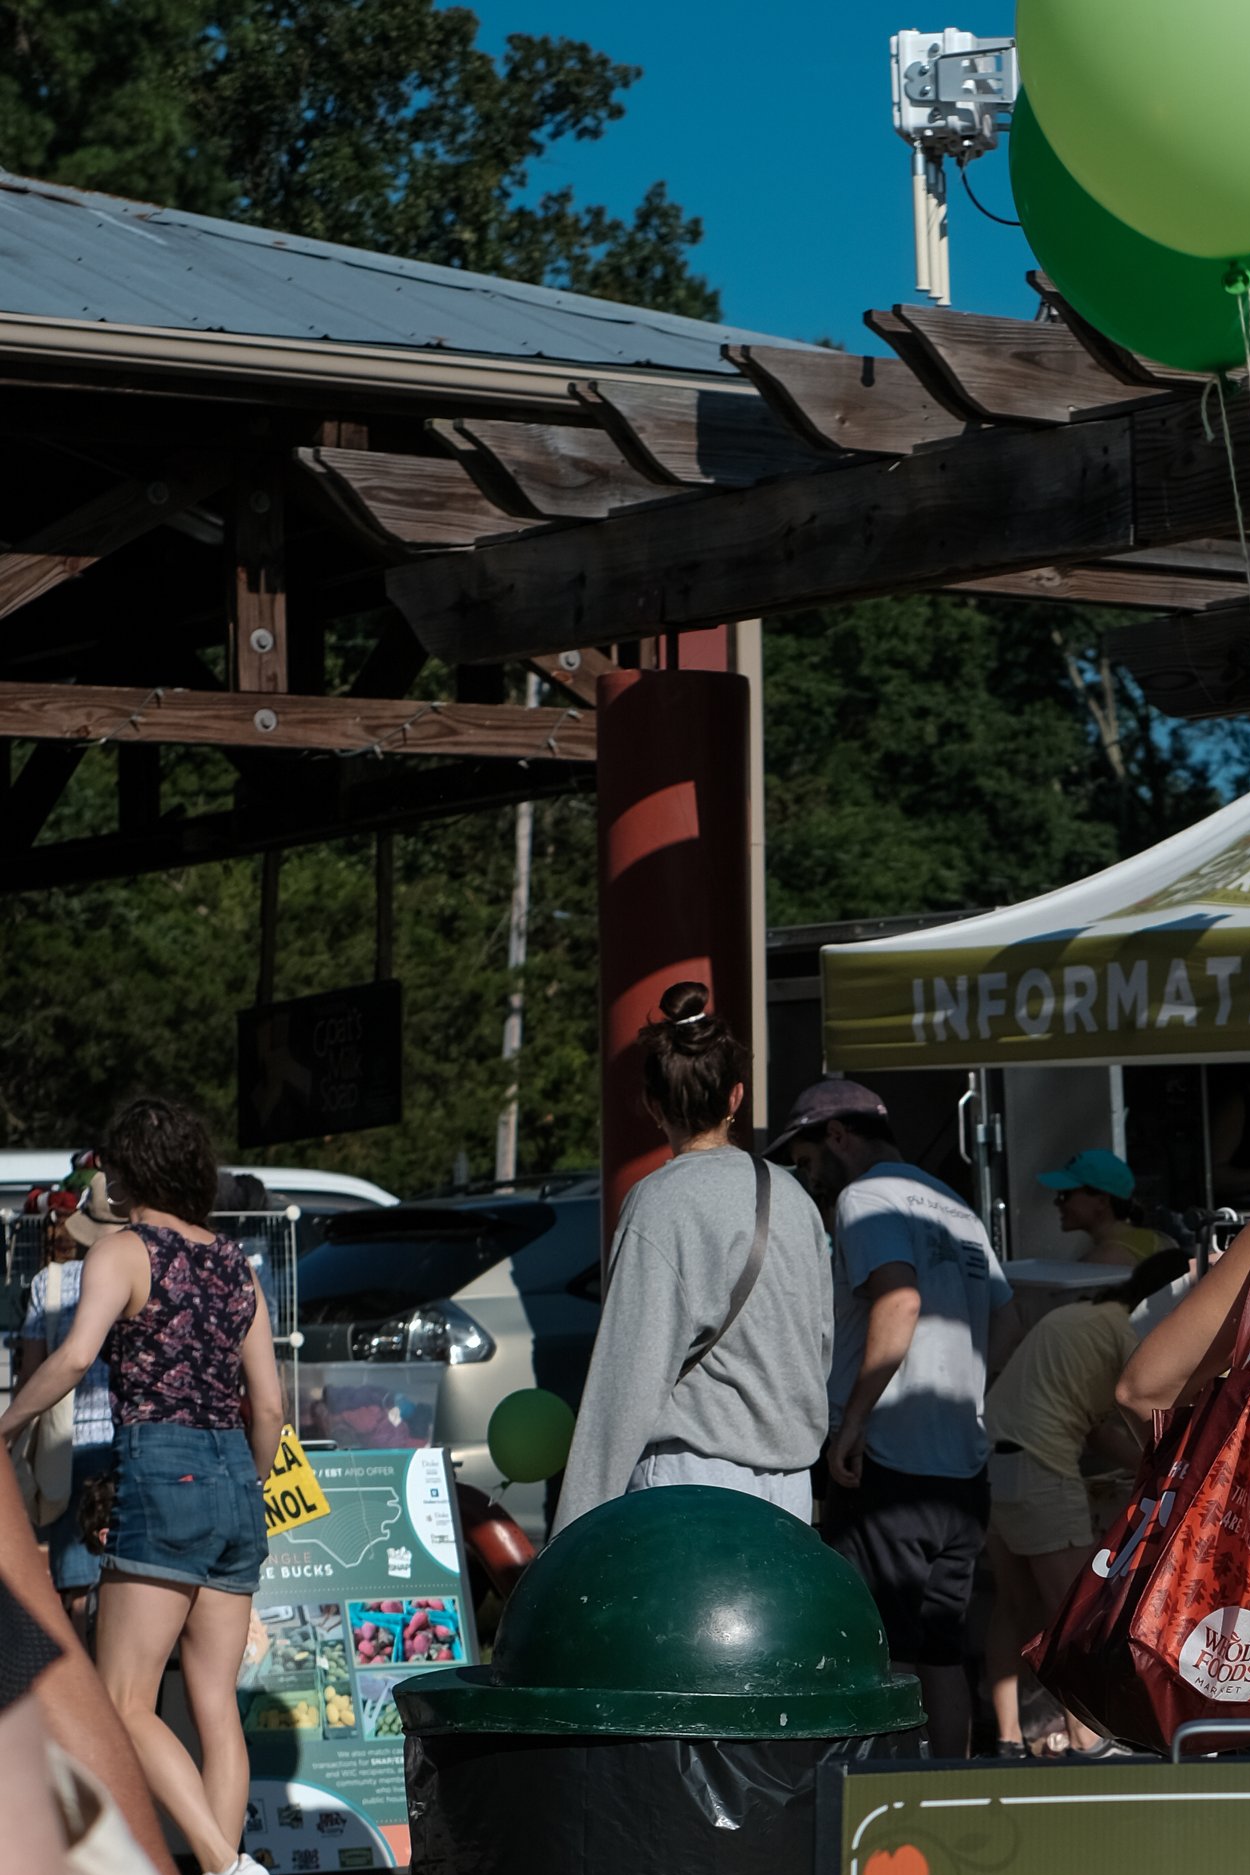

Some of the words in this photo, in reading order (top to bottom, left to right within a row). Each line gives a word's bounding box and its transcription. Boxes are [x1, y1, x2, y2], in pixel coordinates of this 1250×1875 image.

[267, 1441, 303, 1477] LA
[280, 1563, 334, 1579] BUCKS
[1194, 1677, 1242, 1697] MARKET
